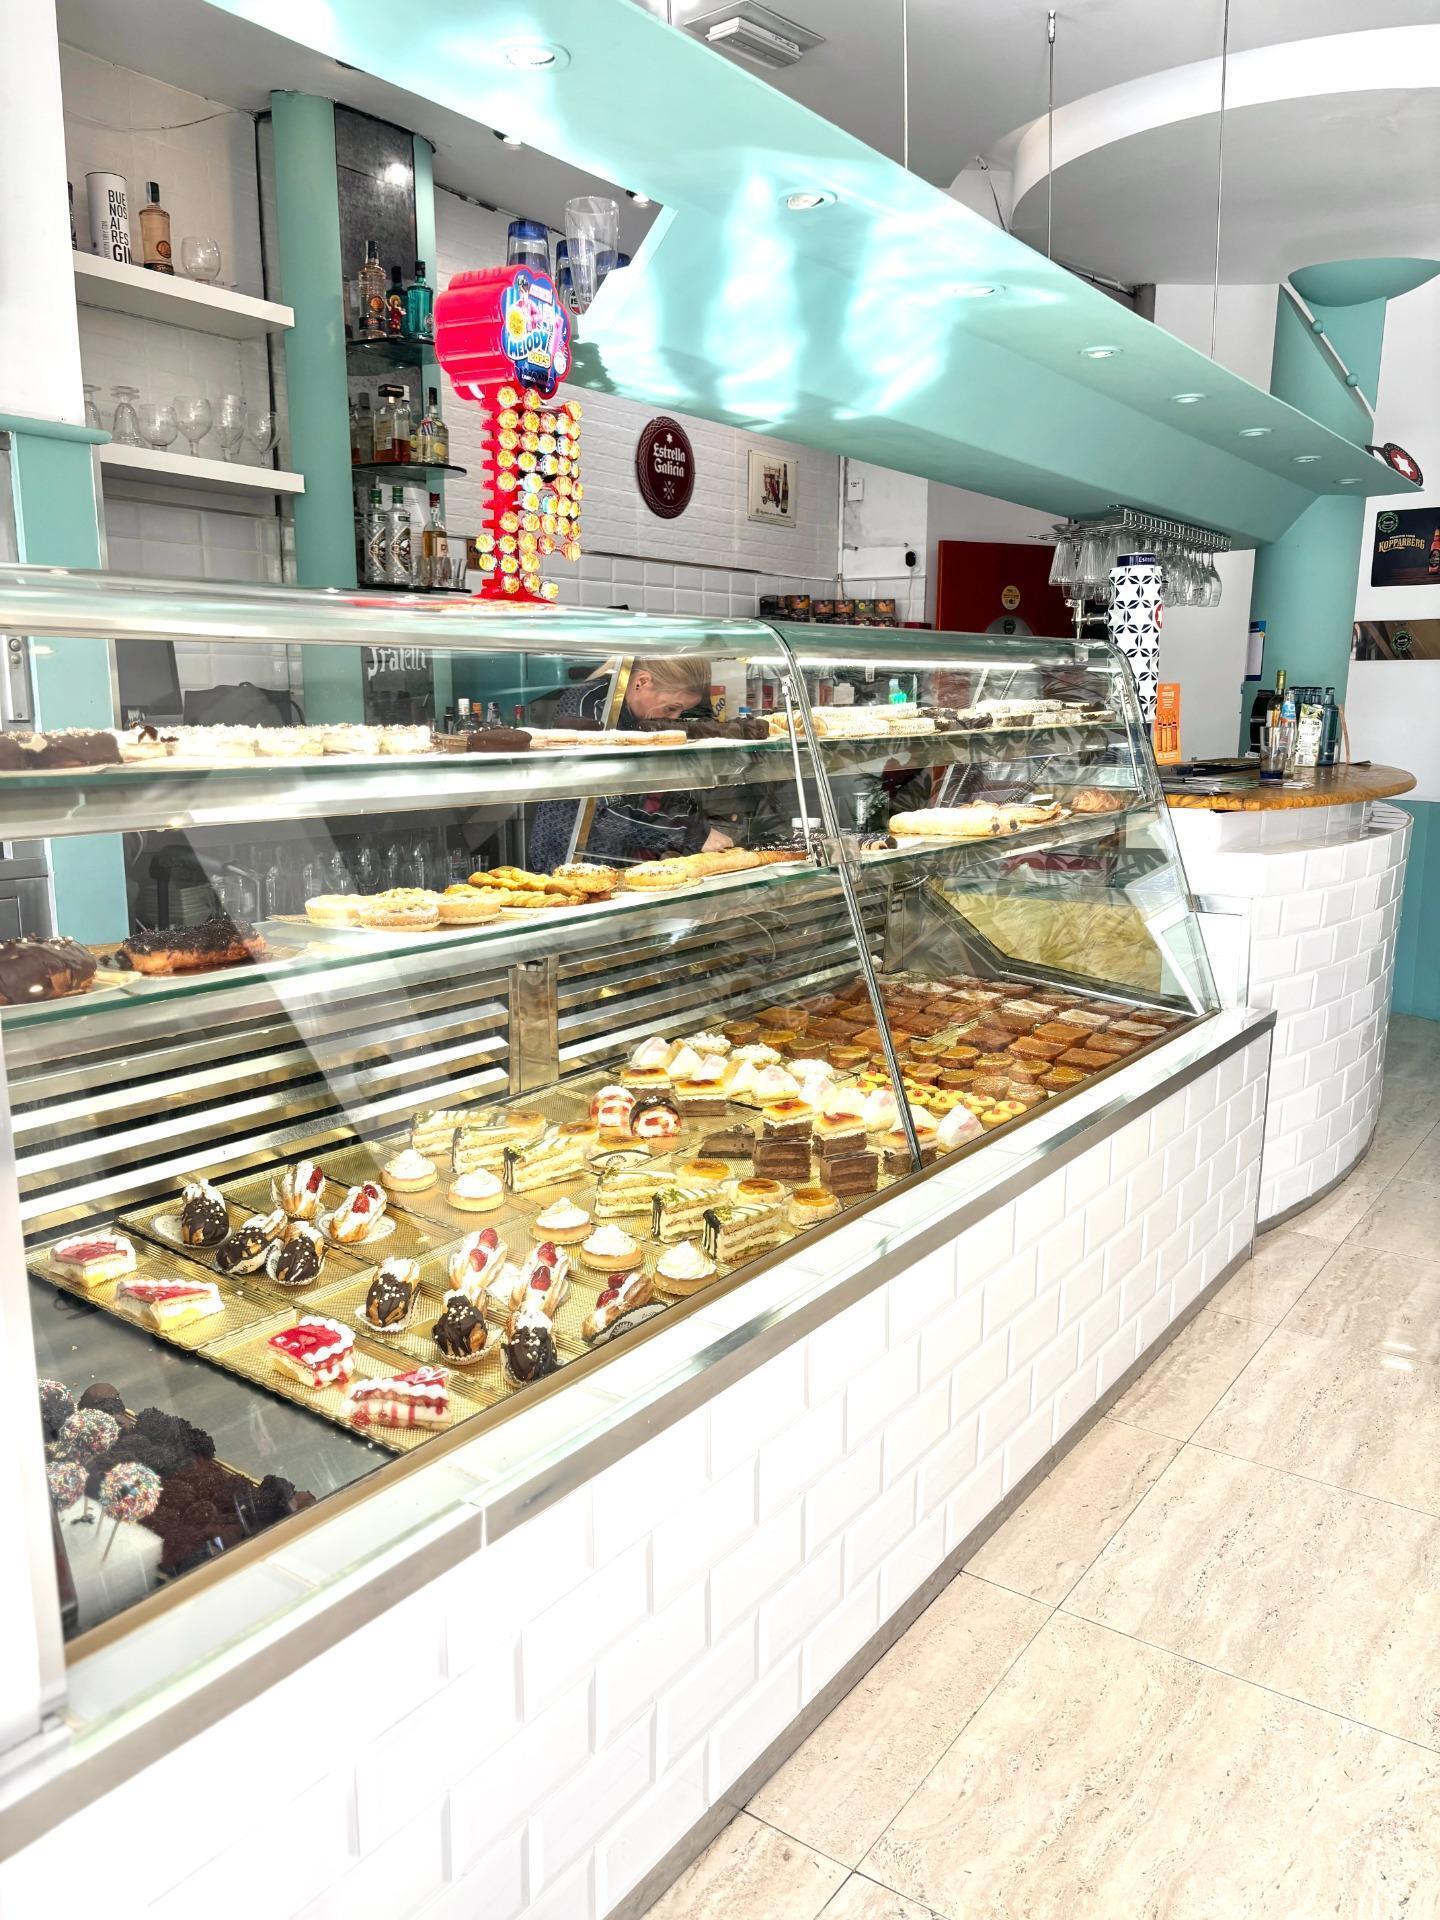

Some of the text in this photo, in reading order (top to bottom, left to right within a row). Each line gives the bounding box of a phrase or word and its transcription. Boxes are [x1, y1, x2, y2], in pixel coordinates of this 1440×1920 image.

[108, 189, 127, 207] BUE
[108, 203, 128, 220] NOS
[110, 217, 120, 231] AI
[111, 230, 129, 246] RES
[508, 331, 549, 358] MELODY
[653, 442, 686, 463] Estrella
[654, 458, 685, 478] Galicia
[1378, 537, 1426, 553] KOPPARBERG
